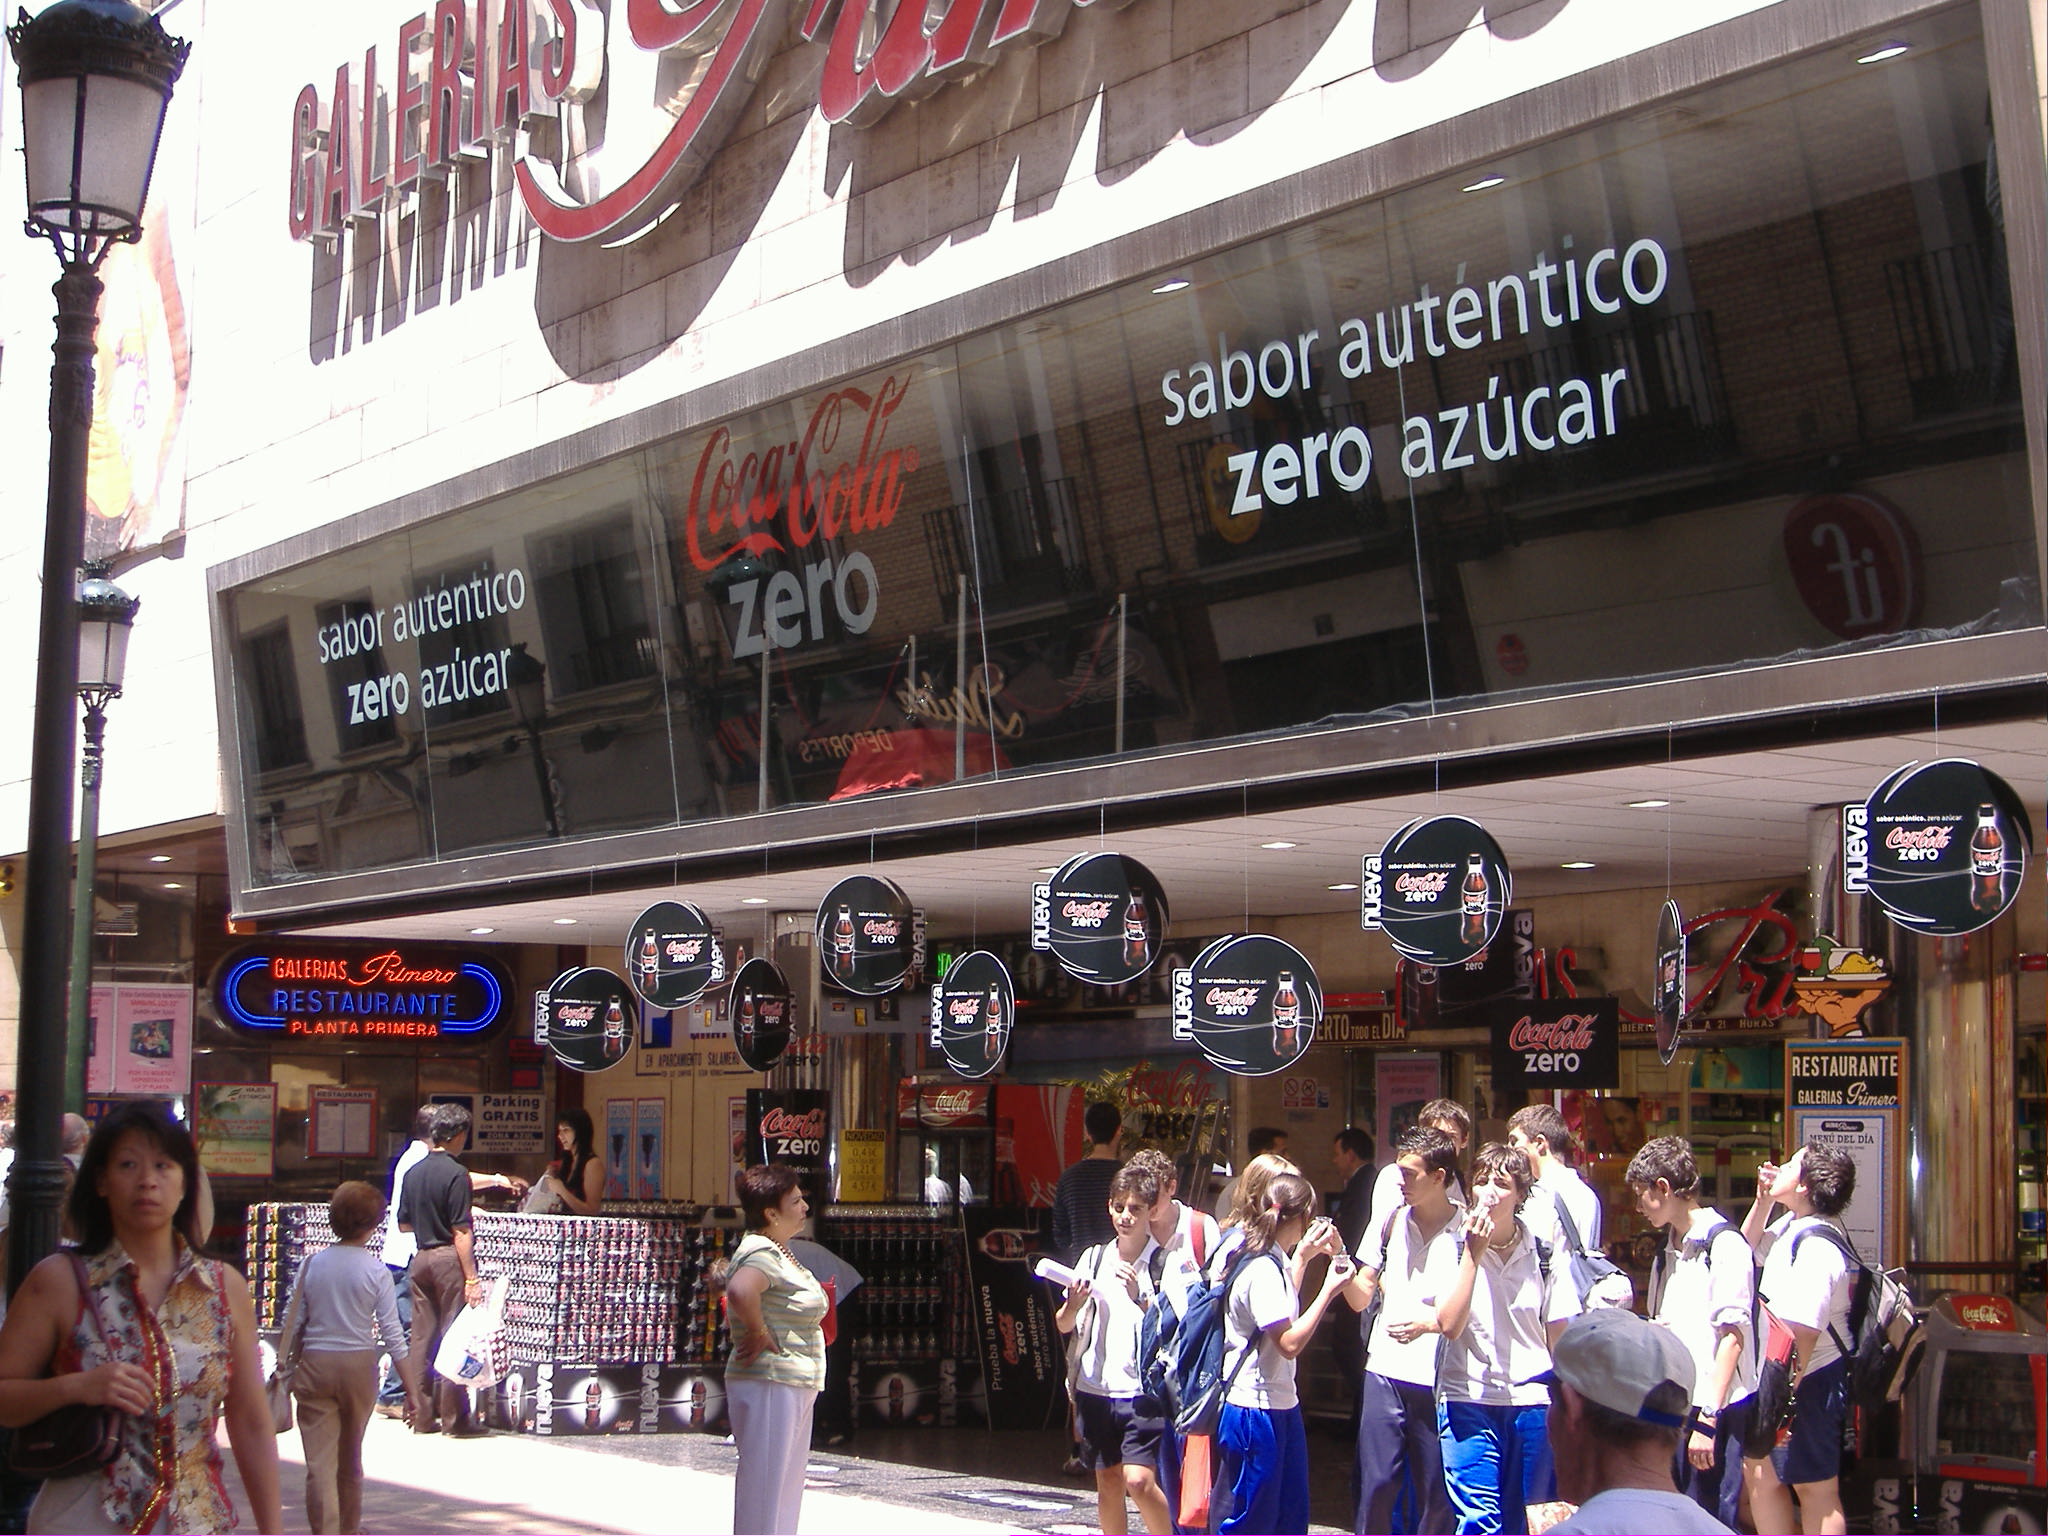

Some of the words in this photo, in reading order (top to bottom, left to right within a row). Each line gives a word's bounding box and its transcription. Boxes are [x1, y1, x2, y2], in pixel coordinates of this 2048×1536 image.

[289, 0, 580, 241] GALERIAS
[1162, 328, 1320, 428] sabor
[1338, 232, 1669, 380] auténtico
[1227, 426, 1374, 517] zero
[1399, 366, 1629, 480] azúcar
[686, 374, 911, 573] Coca-Cola
[318, 605, 386, 665] sabor
[391, 560, 528, 644] auténtico
[728, 551, 883, 660] zero
[347, 671, 411, 727] zero
[420, 645, 513, 711] azúcar
[1847, 808, 1868, 890] nueva
[1886, 826, 1954, 849] Coca-Cola
[1898, 848, 1939, 861] zero
[1365, 857, 1382, 927] nueva
[1395, 872, 1449, 893] Coca-Cola
[1405, 890, 1437, 902] zero
[1034, 885, 1051, 947] nueva
[1062, 900, 1113, 919] Coca-Cola
[1071, 917, 1102, 927] zero
[871, 934, 895, 944] zero
[912, 908, 926, 968] nueva
[274, 957, 348, 980] GALERIAS
[348, 950, 457, 987] Primero
[672, 953, 695, 963] zero
[1465, 961, 1484, 971] zero
[1513, 911, 1534, 999] ueva
[272, 988, 457, 1017] RESTAURANTE
[1175, 971, 1193, 1037] nueva
[1205, 987, 1260, 1006] Coca-Cola
[1215, 1004, 1248, 1016] zero
[291, 1020, 359, 1036] PLANTA
[364, 1020, 438, 1037] PRIMERA
[537, 992, 550, 1042] nueva
[564, 1018, 588, 1028] zero
[764, 1015, 780, 1024] zero
[932, 985, 943, 1045] nueva
[954, 1014, 974, 1025] zero
[1315, 1013, 1350, 1041] ERTO
[1351, 1025, 1370, 1040] TODO
[1372, 1026, 1380, 1040] EL
[1704, 1020, 1712, 1030] A
[1509, 1013, 1598, 1051] Coca-Cola
[1524, 1052, 1580, 1073] zero
[1792, 1055, 1899, 1077] RESTAURANTE
[1127, 1059, 1222, 1109] Coca-Cola
[1798, 1089, 1843, 1105] GALERIAS
[1846, 1081, 1898, 1106] Primero
[483, 1095, 540, 1109] Parking
[935, 1089, 973, 1114] Coca-Cola
[482, 1111, 539, 1122] GRATIS
[777, 1139, 820, 1155] zero
[1837, 1134, 1856, 1144] DEL
[1858, 1133, 1875, 1144] DÍA
[981, 1284, 995, 1326] nueva
[1963, 1305, 2000, 1324] Coca-Cola
[985, 1329, 996, 1341] la
[1015, 1320, 1028, 1356] zero
[989, 1343, 1003, 1391] Prueba
[1033, 1351, 1045, 1381] sabor
[536, 1363, 554, 1434] nueva
[639, 1363, 661, 1433] nueva
[1873, 1479, 1900, 1535] eva
[1939, 1480, 1964, 1535] eva
